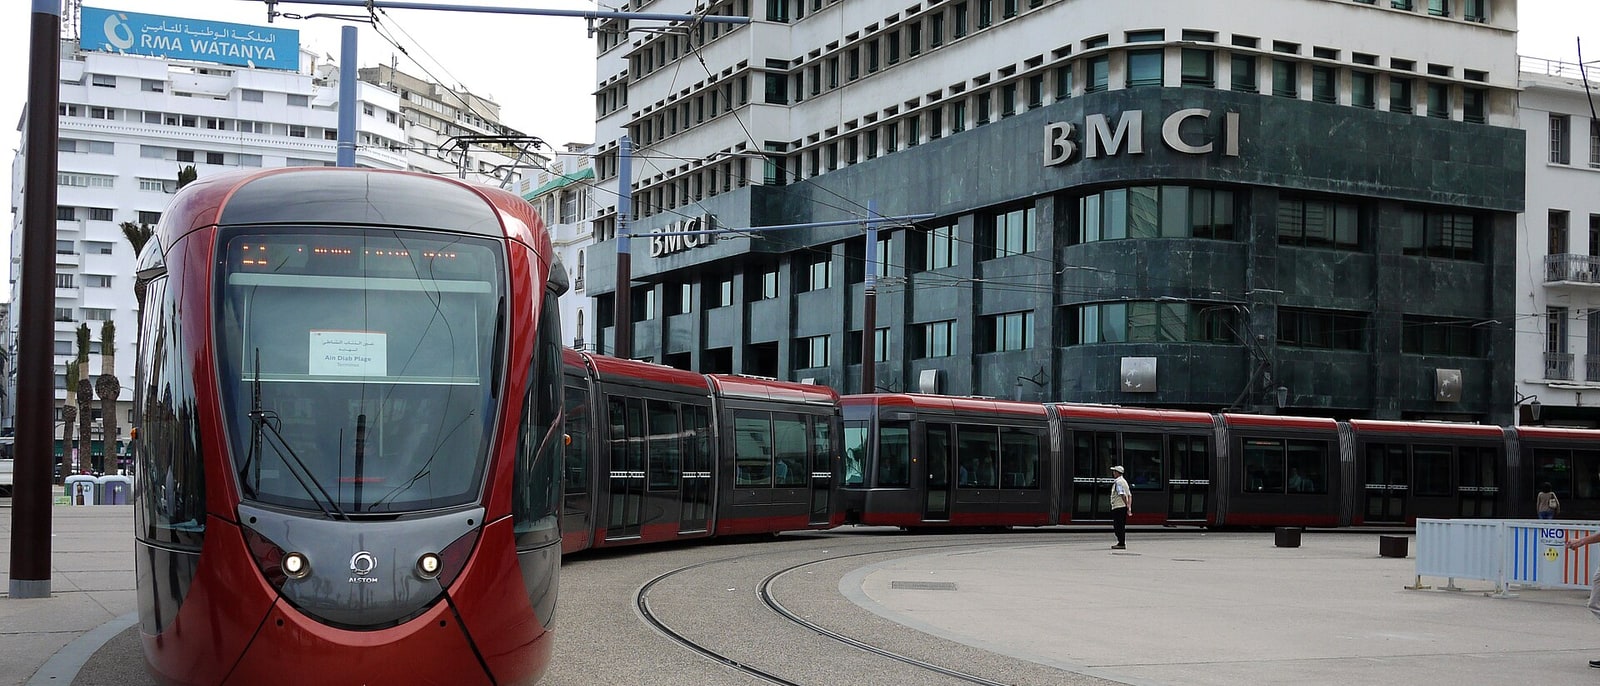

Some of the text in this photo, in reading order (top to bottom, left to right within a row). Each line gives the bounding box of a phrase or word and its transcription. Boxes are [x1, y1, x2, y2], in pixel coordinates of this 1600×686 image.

[184, 25, 229, 40] الوطنية
[231, 30, 276, 43] الملكية
[141, 34, 276, 61] RMA WATANYA
[1043, 108, 1240, 168] BMCI
[649, 213, 710, 258] BMCI
[354, 355, 372, 363] Plage
[1541, 527, 1564, 539] NEO
